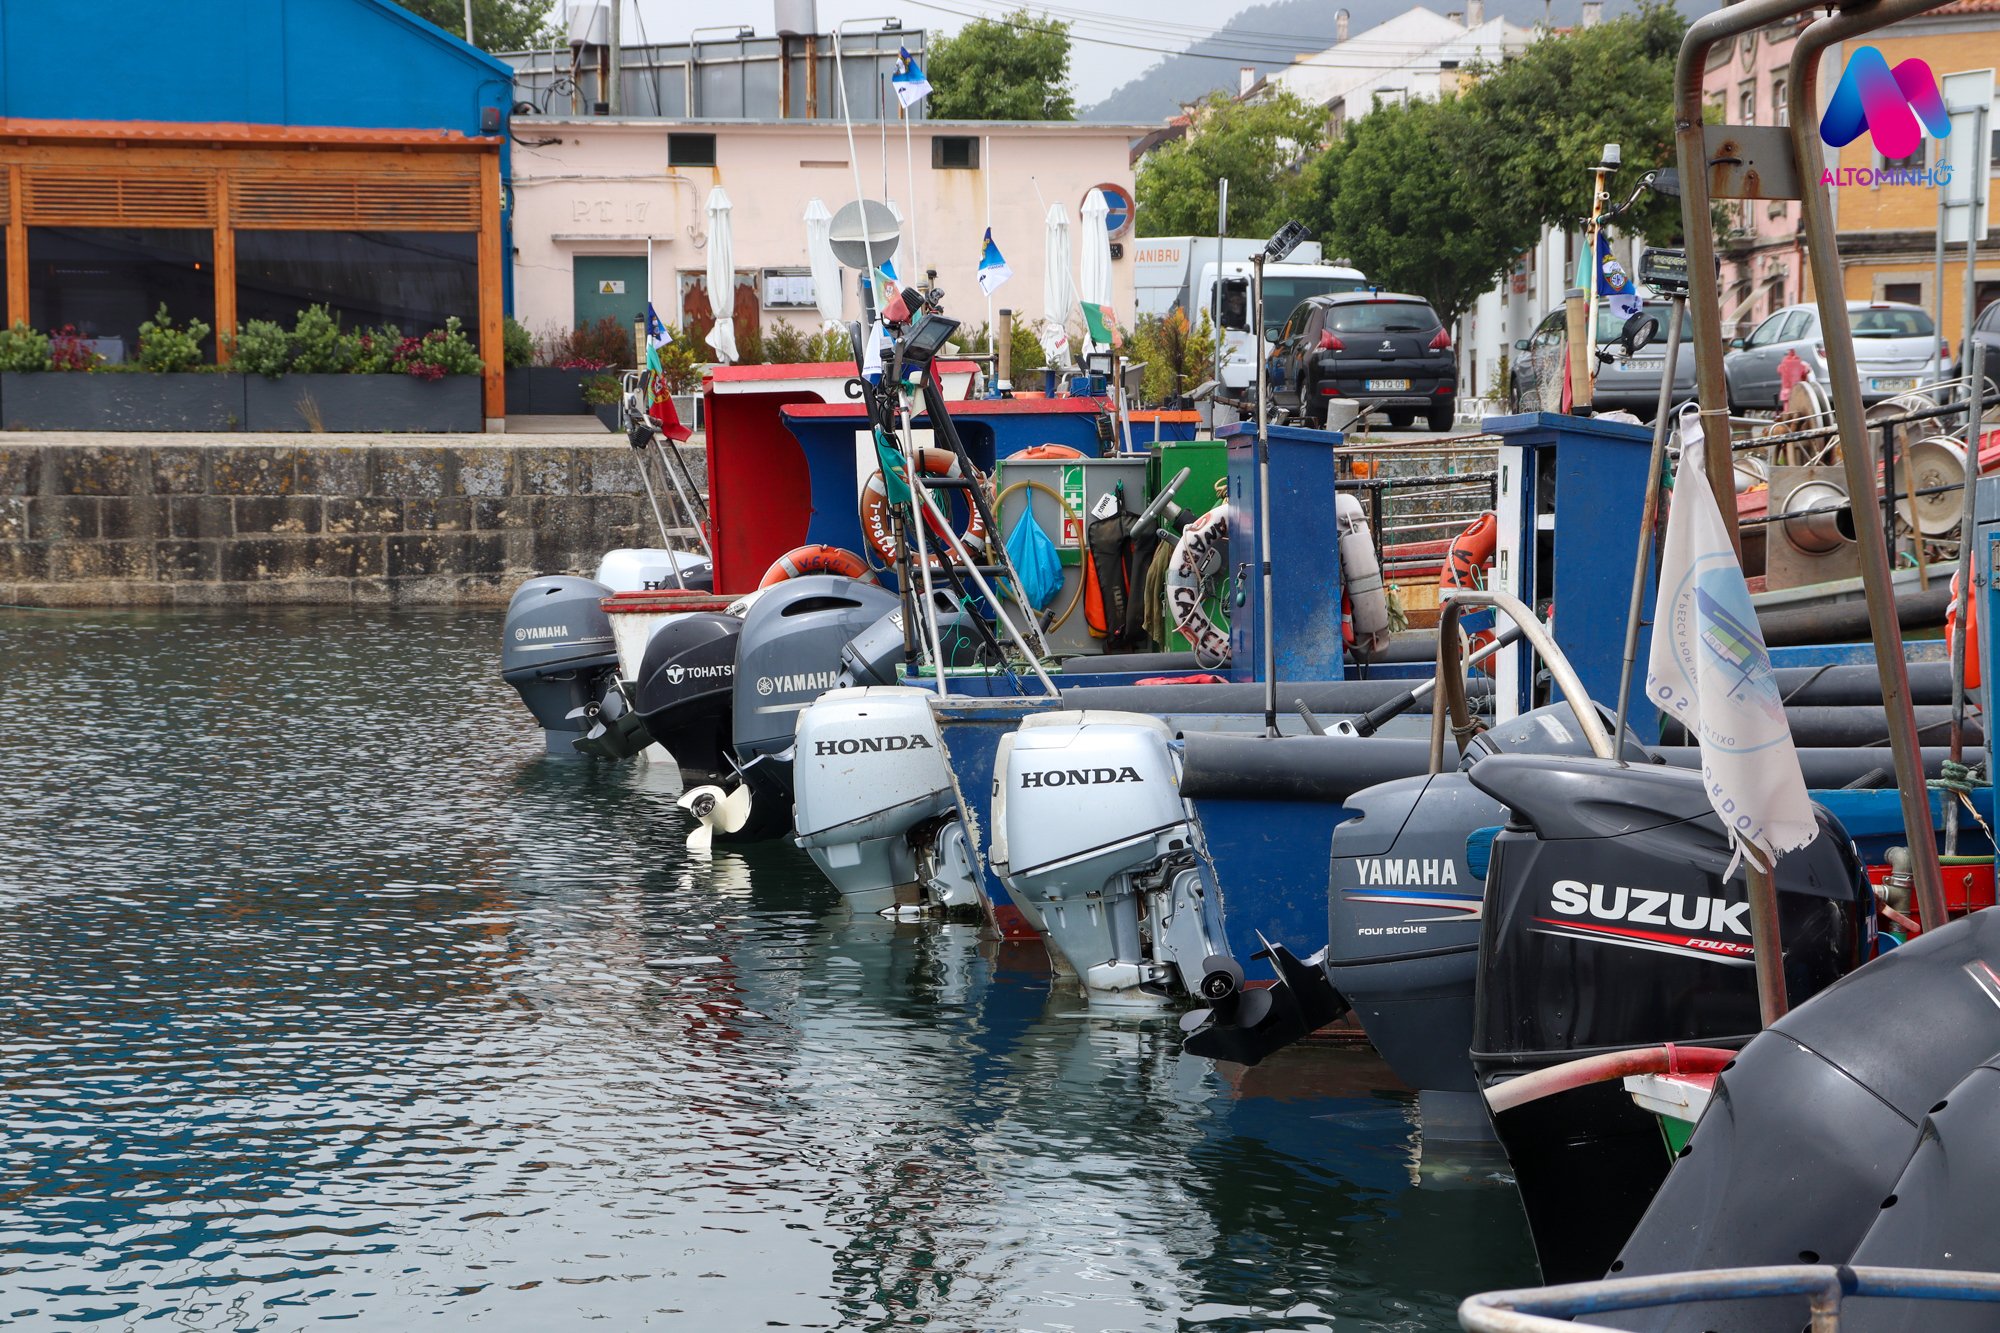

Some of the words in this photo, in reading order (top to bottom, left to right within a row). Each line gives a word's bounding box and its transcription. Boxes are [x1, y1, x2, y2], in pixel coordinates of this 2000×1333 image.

[624, 200, 650, 223] 17
[526, 625, 569, 640] YAMAHA
[773, 671, 837, 694] YAMAHA
[814, 734, 933, 756] HONDA
[1021, 766, 1144, 788] HONDA
[1356, 858, 1458, 885] YAMAHA
[1550, 879, 1752, 937] SUZUK
